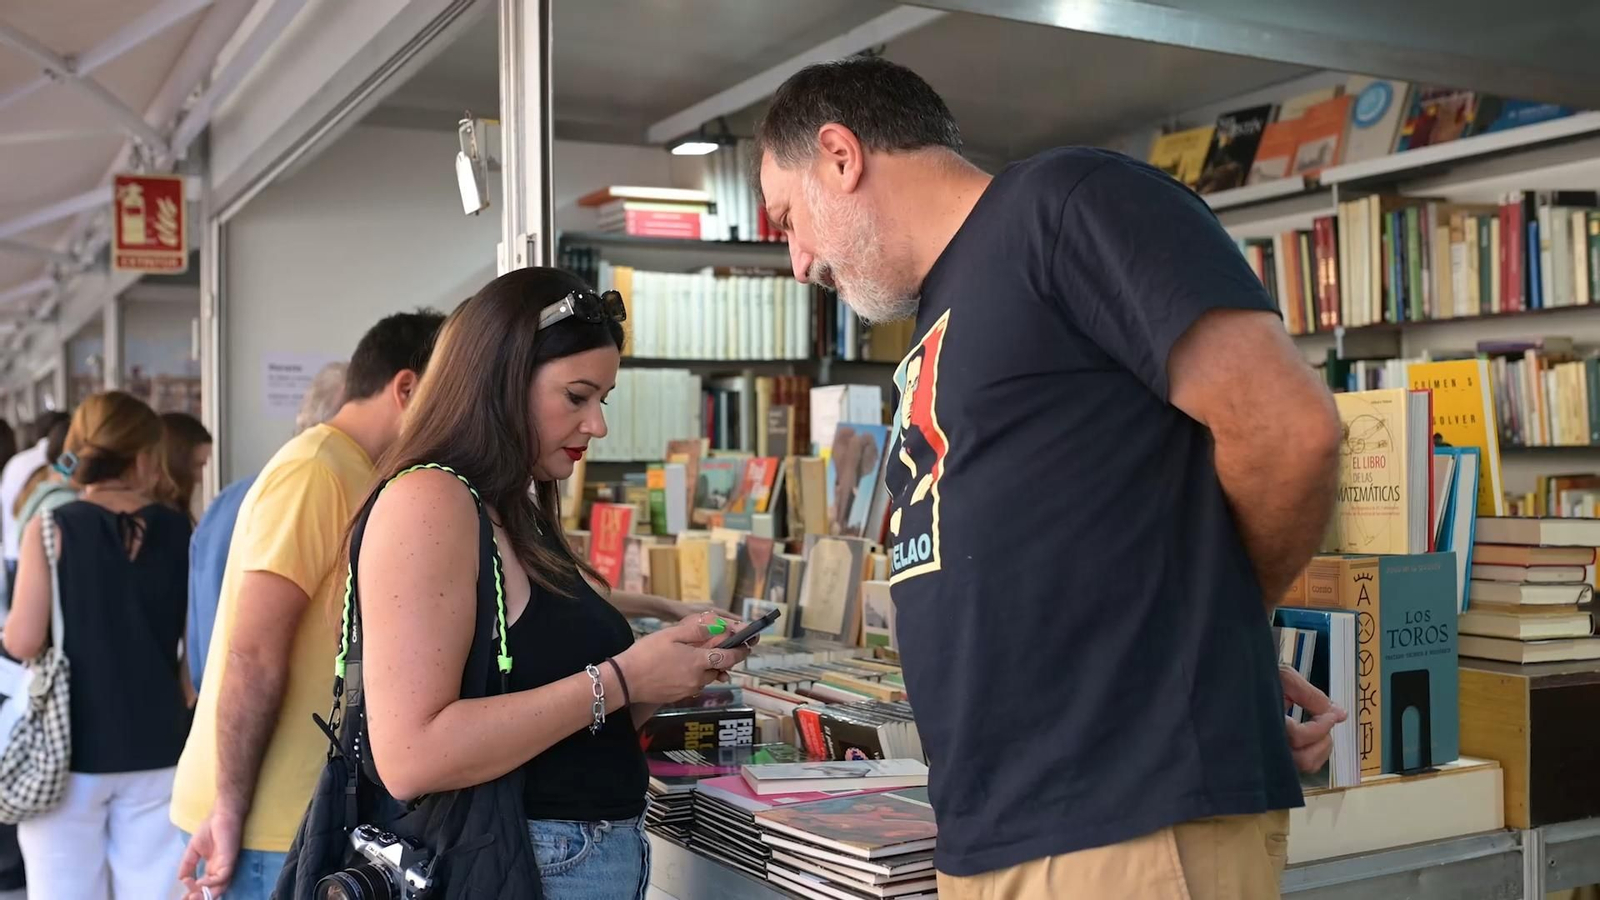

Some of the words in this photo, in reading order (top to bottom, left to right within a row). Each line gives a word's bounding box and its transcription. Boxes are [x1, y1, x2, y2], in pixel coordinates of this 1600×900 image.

[1352, 456, 1361, 470] EL
[1362, 455, 1386, 469] LIBRO
[1352, 472, 1361, 483] DE
[1361, 472, 1374, 483] LAS
[1405, 609, 1432, 625] LOS
[1386, 623, 1449, 649] TOROS
